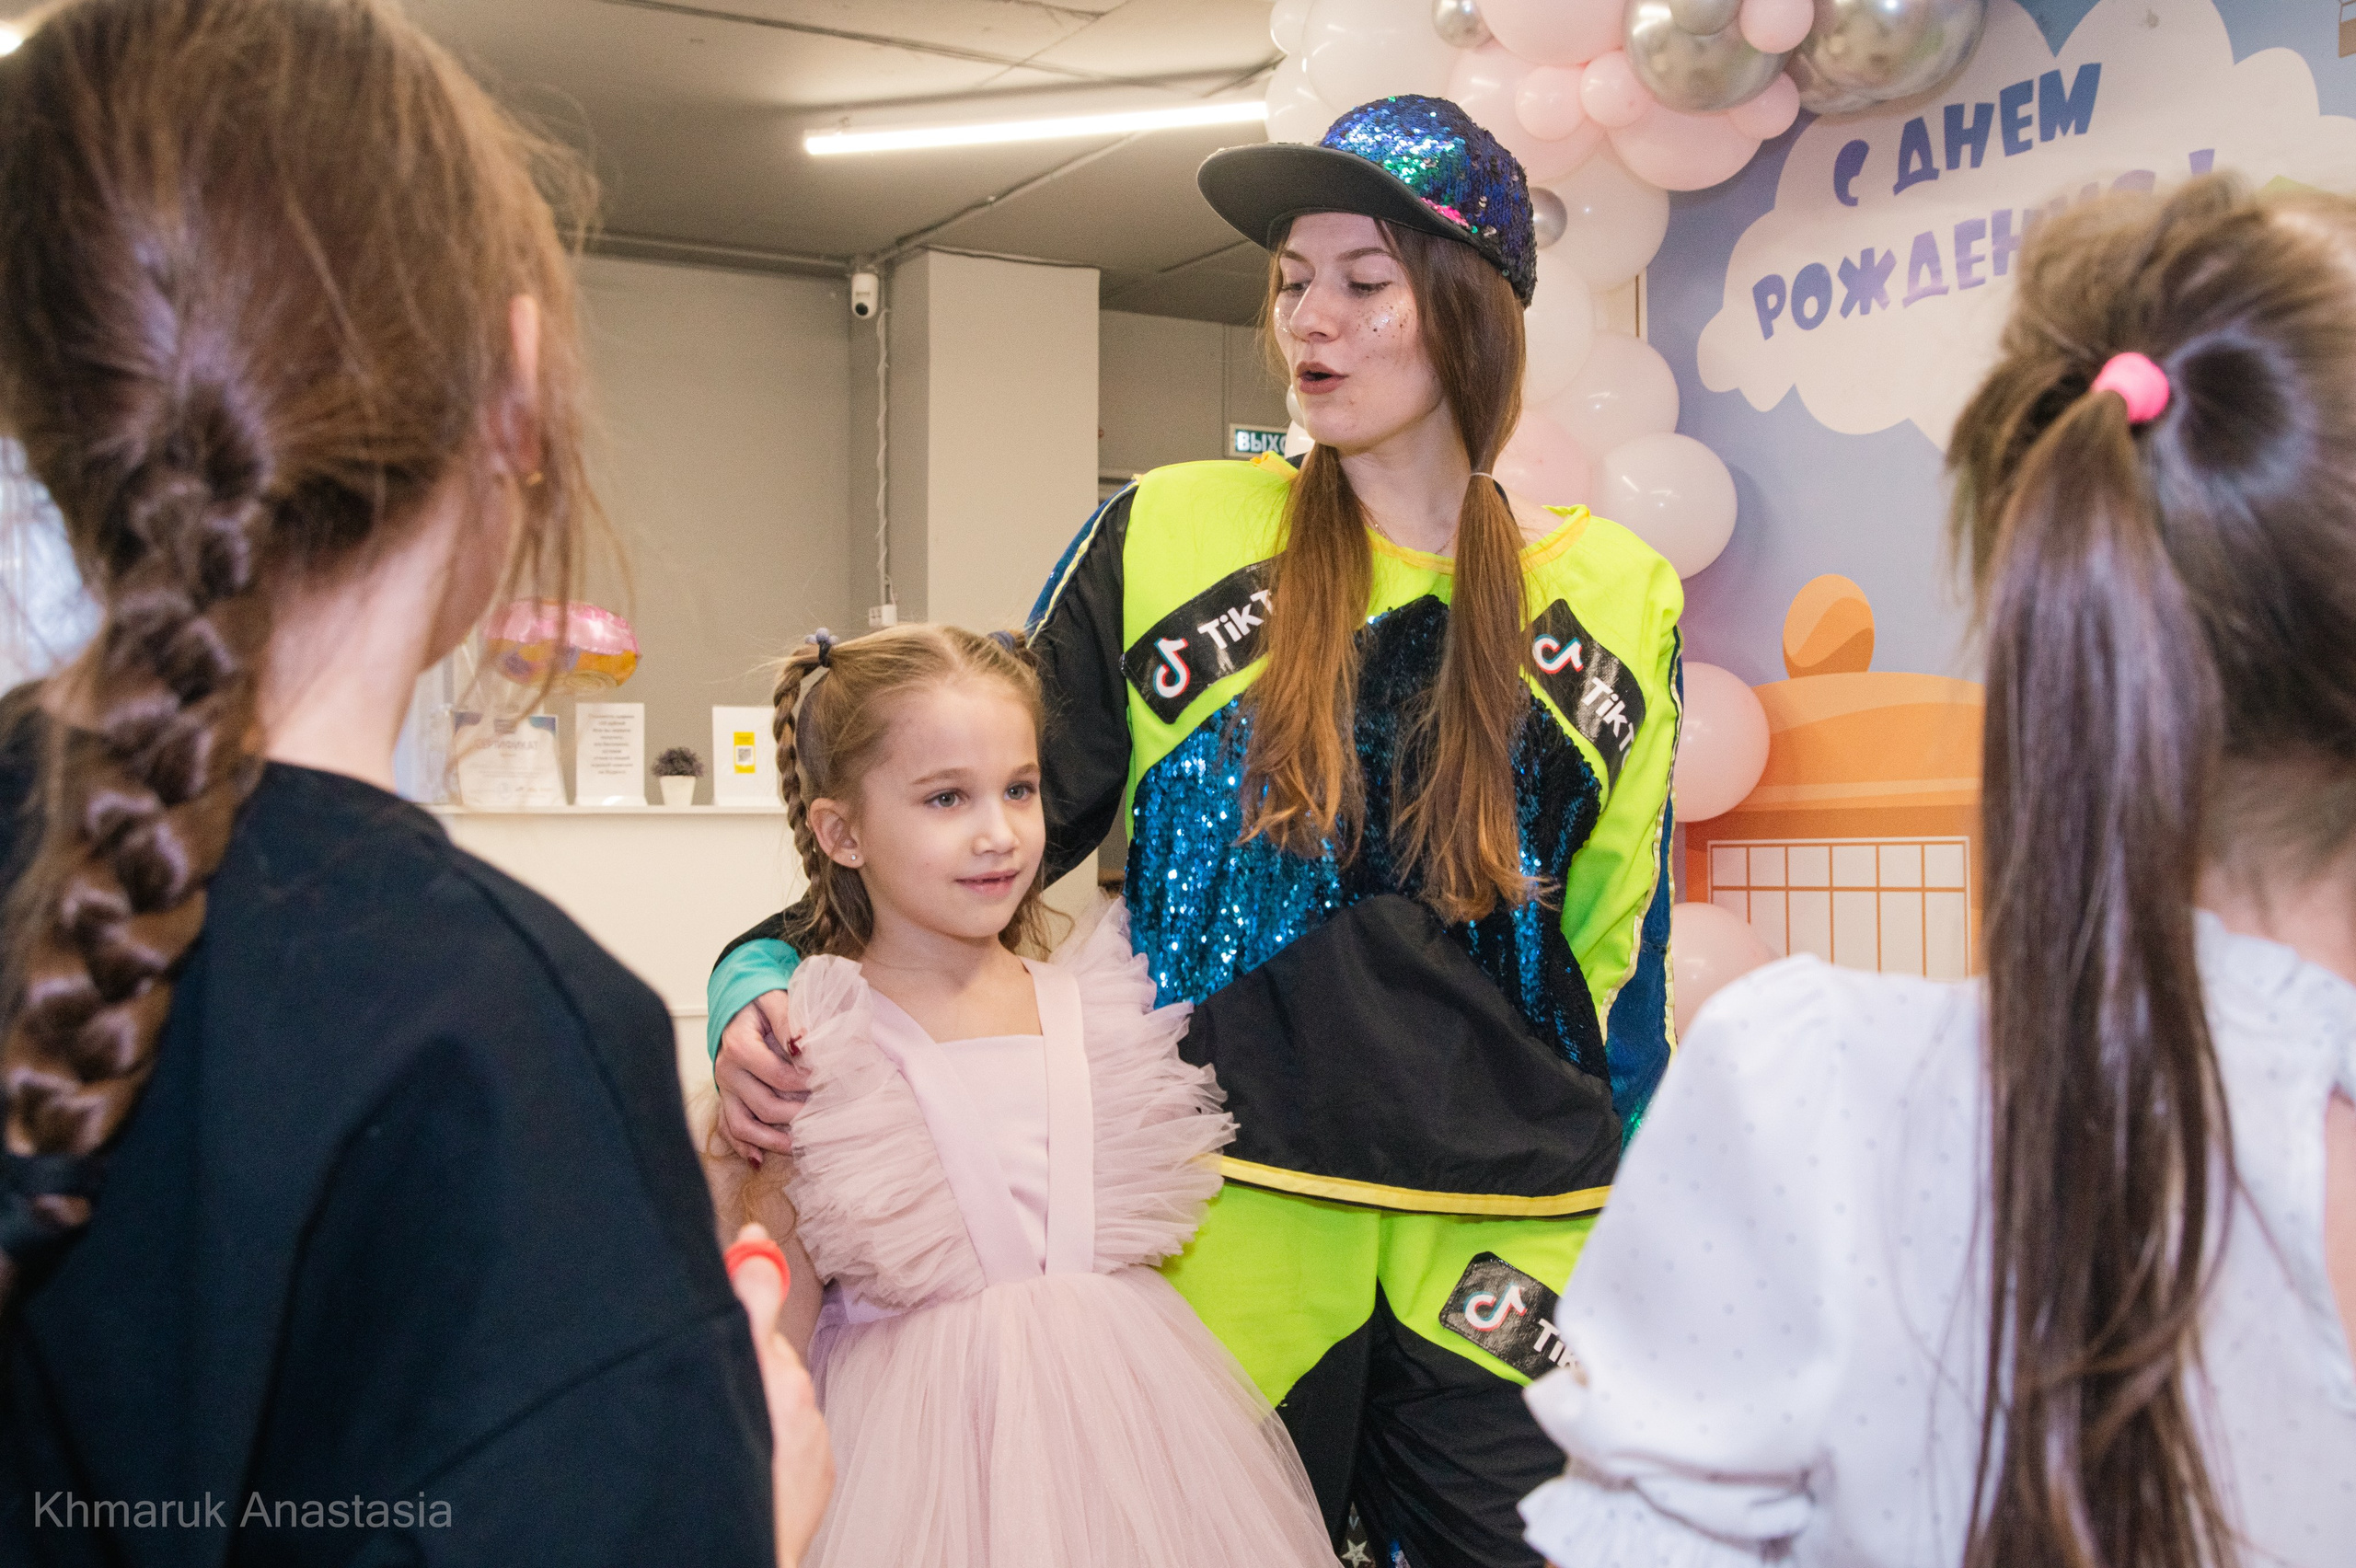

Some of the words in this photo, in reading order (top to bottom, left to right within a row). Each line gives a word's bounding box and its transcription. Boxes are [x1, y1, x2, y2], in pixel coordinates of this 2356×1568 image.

[1833, 139, 1870, 208] С
[1893, 62, 2103, 196] ДНЕМ
[1751, 149, 2216, 341] РОЖДЕН
[1581, 676, 1635, 770] TikT
